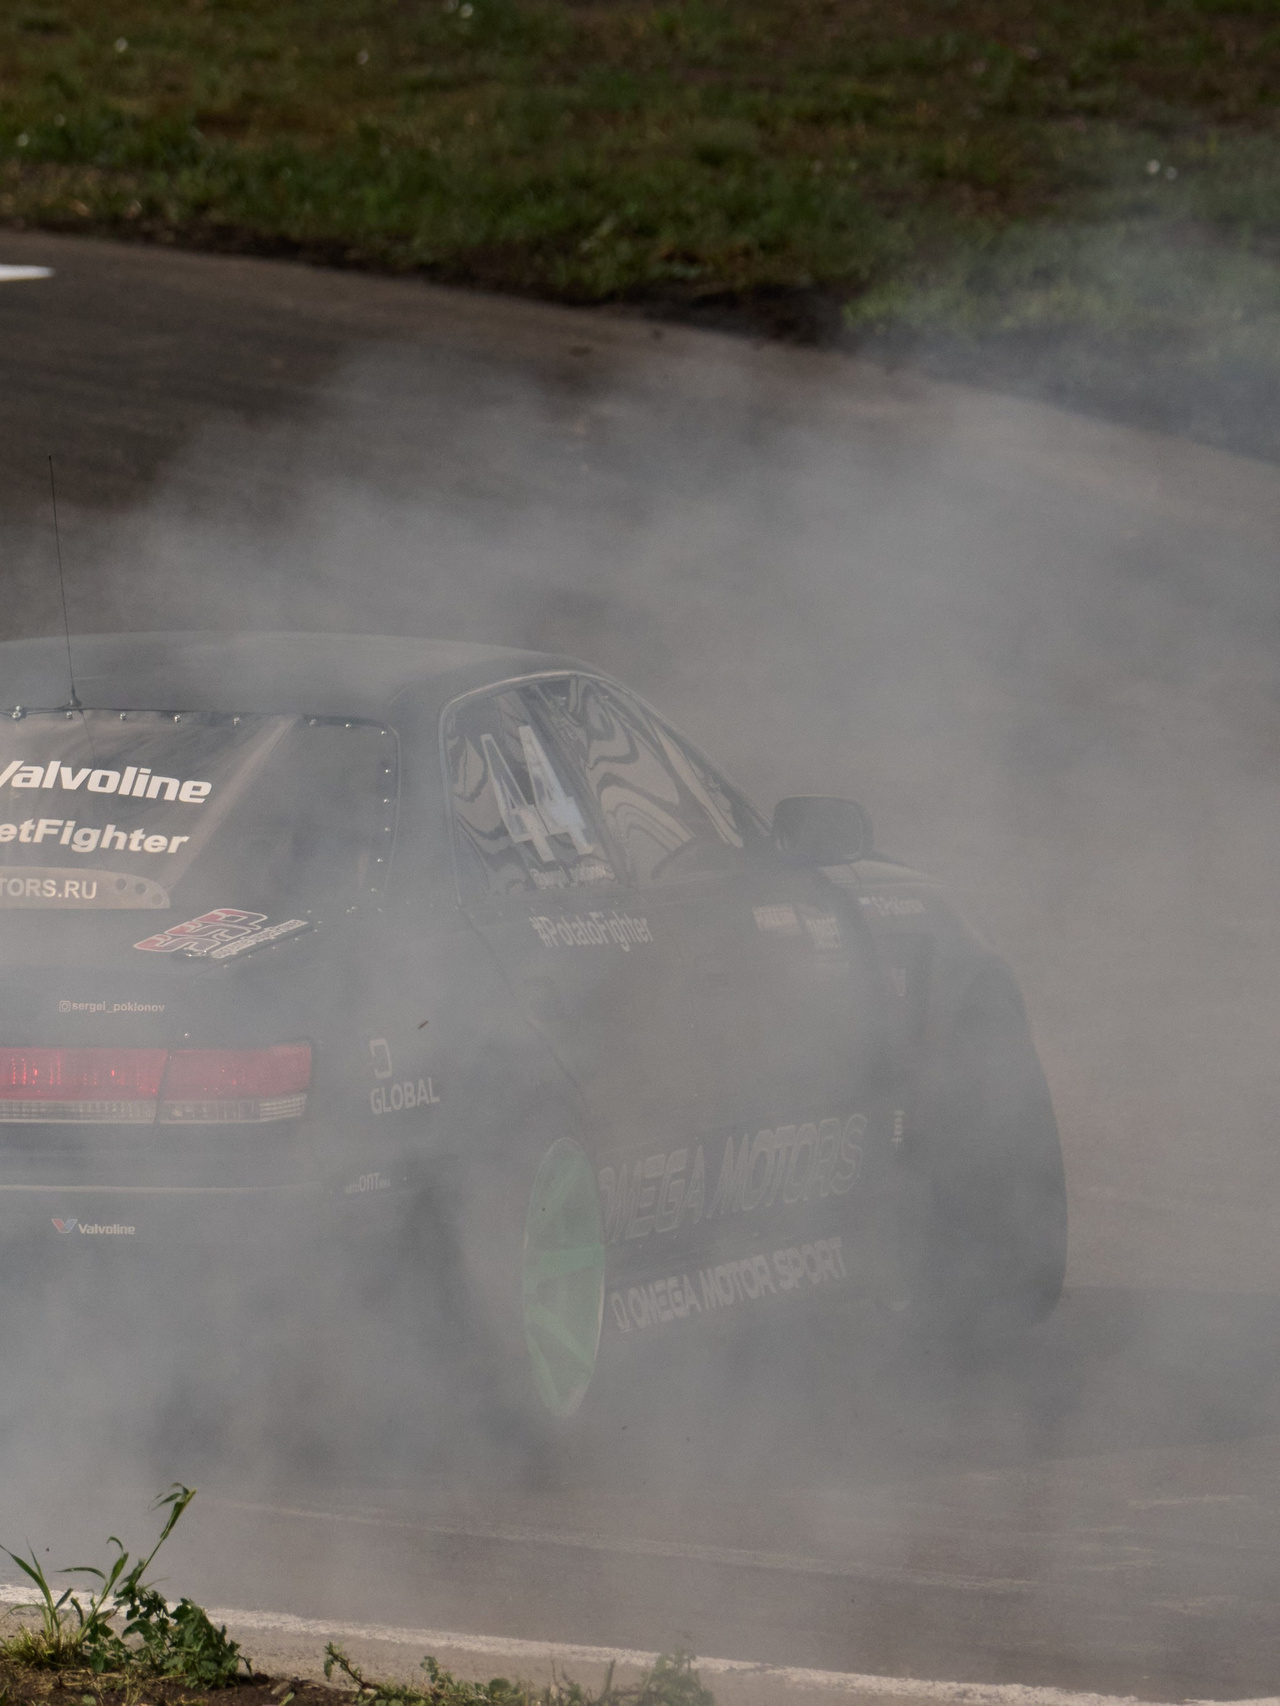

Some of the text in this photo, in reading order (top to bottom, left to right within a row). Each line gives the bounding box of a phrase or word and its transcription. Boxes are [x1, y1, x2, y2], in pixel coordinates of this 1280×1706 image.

[528, 911, 654, 953] #PotatoFighter
[370, 1076, 441, 1116] GLOBAL
[706, 1113, 868, 1221] MOTORS
[78, 1223, 136, 1235] Valvoline
[628, 1274, 702, 1329] OMEGA
[699, 1253, 778, 1311] MOTOR
[772, 1236, 848, 1291] SPORT
